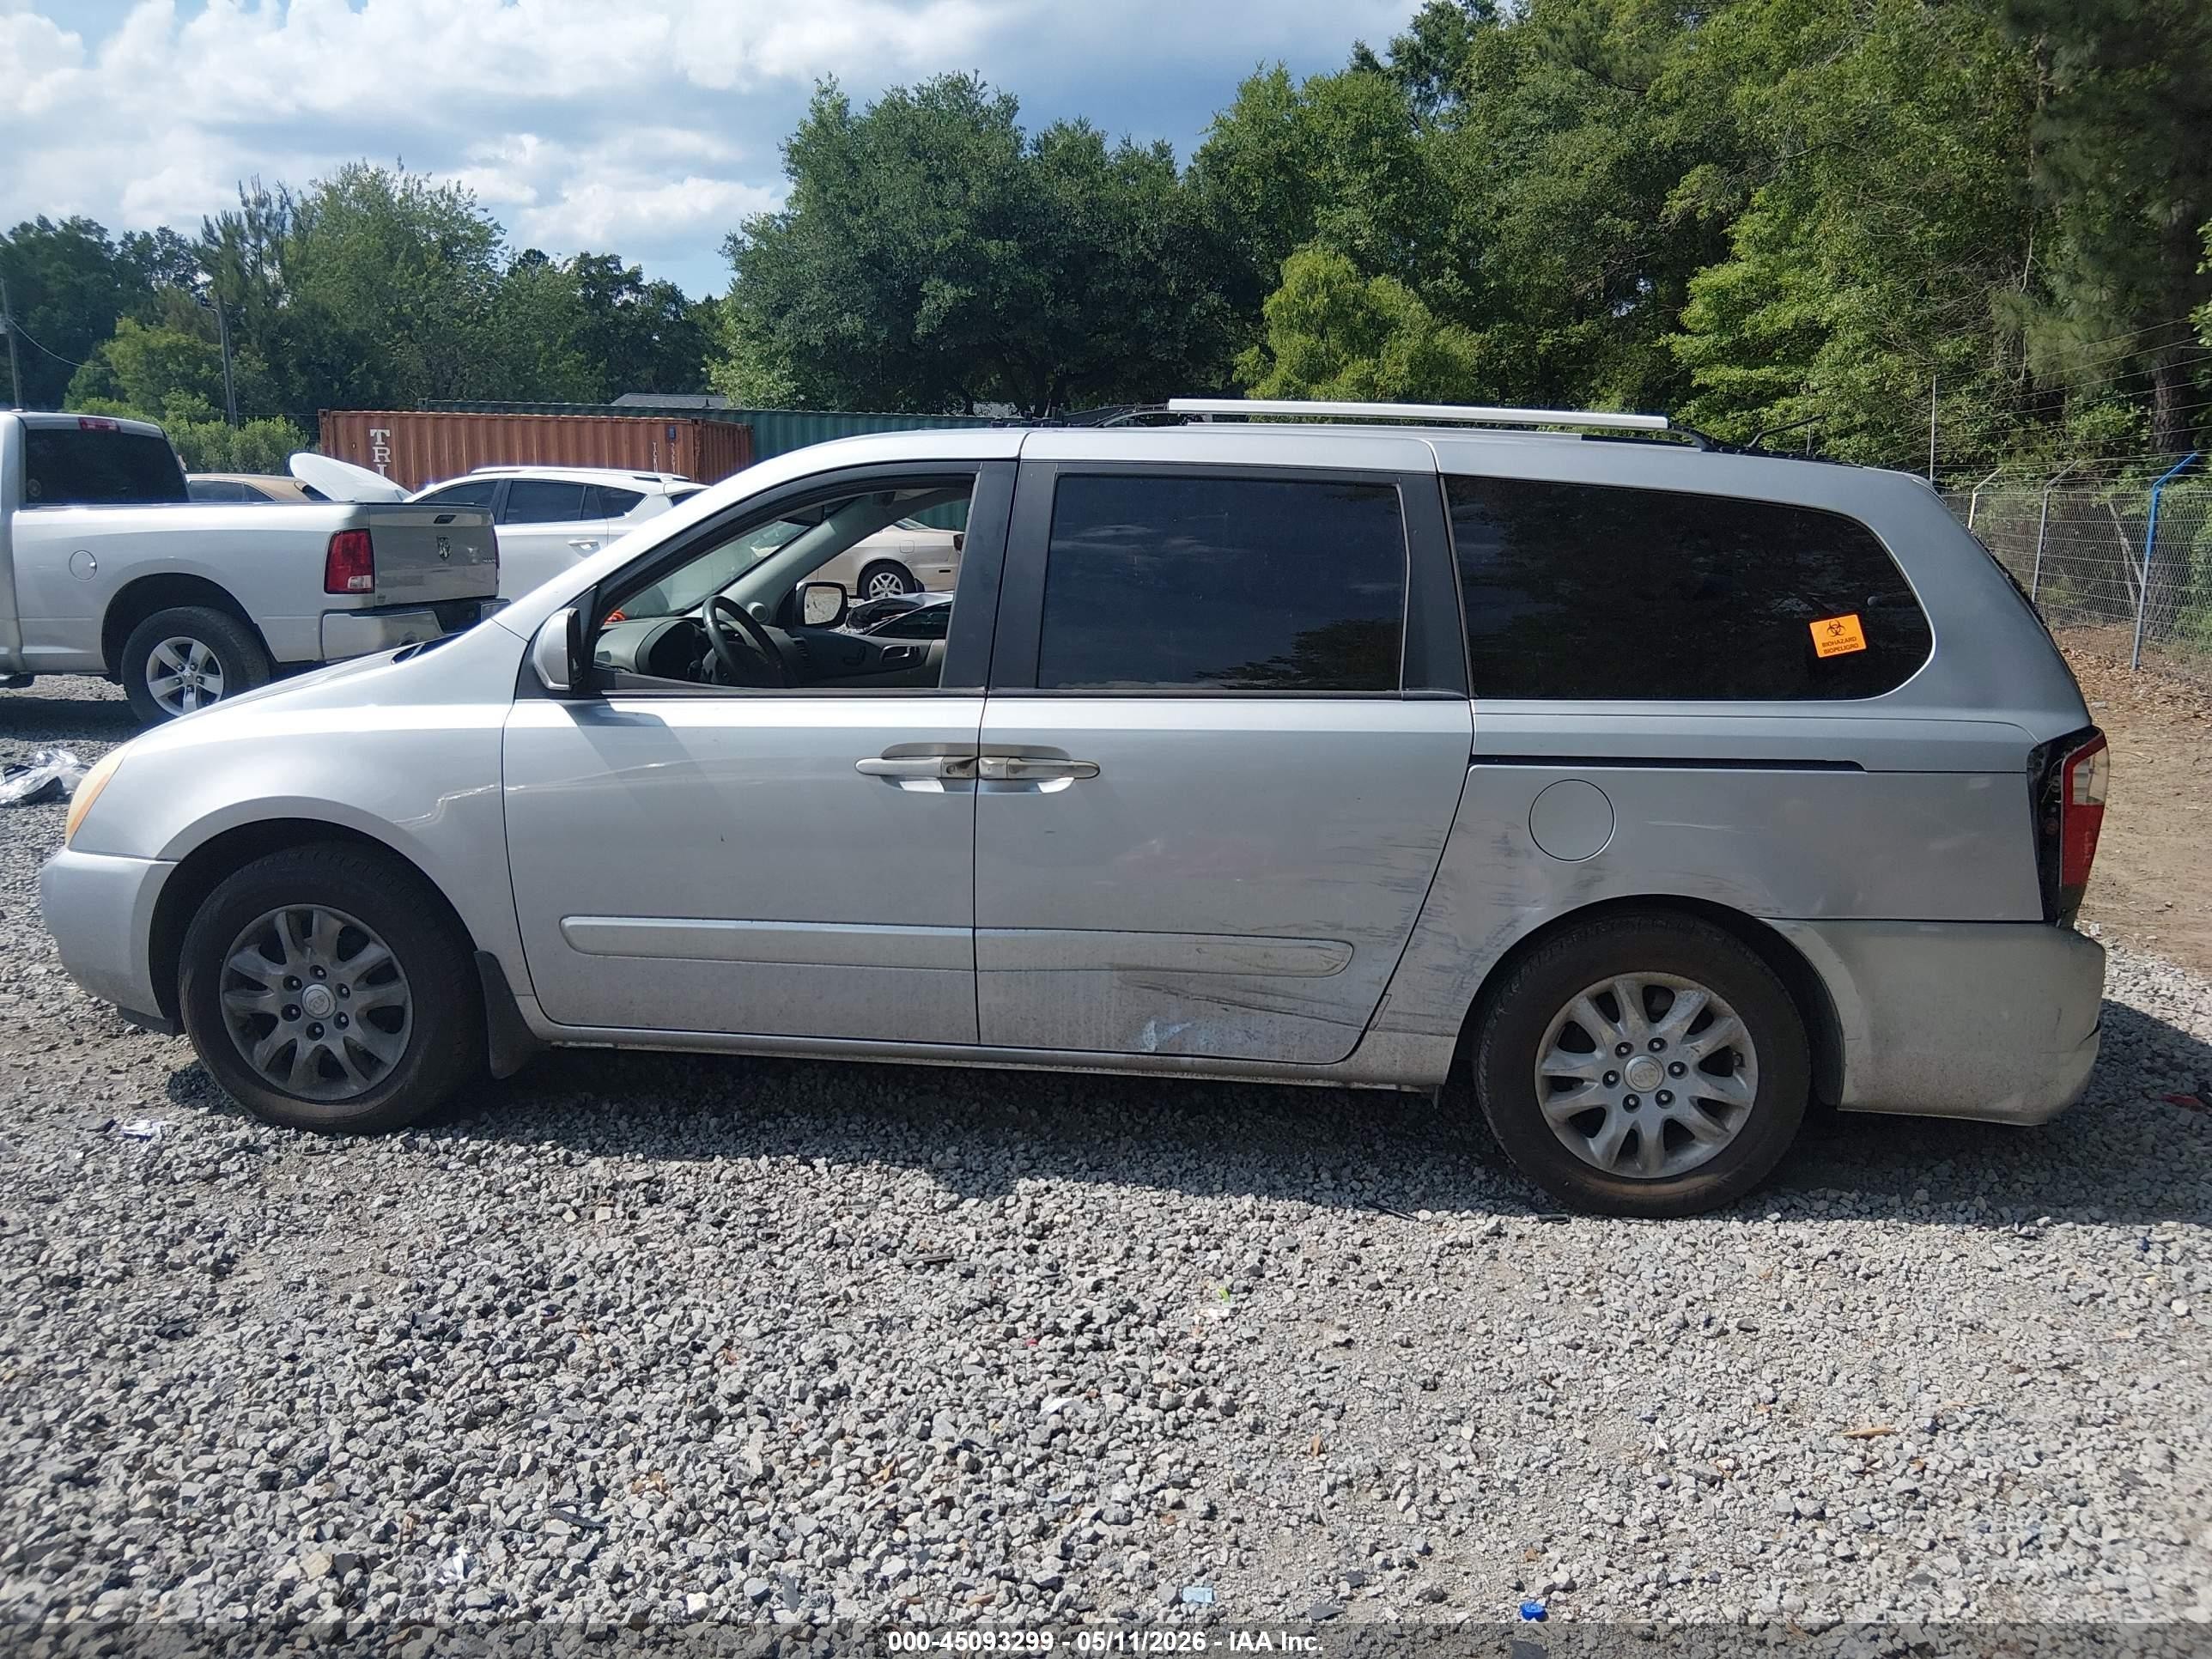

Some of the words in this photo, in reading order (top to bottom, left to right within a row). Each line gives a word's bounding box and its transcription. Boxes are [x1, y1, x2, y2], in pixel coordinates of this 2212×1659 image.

[370, 428, 392, 477] TRI
[1822, 636, 1856, 647] BIOHAZARD
[1824, 643, 1859, 653] BIOPELIGRO
